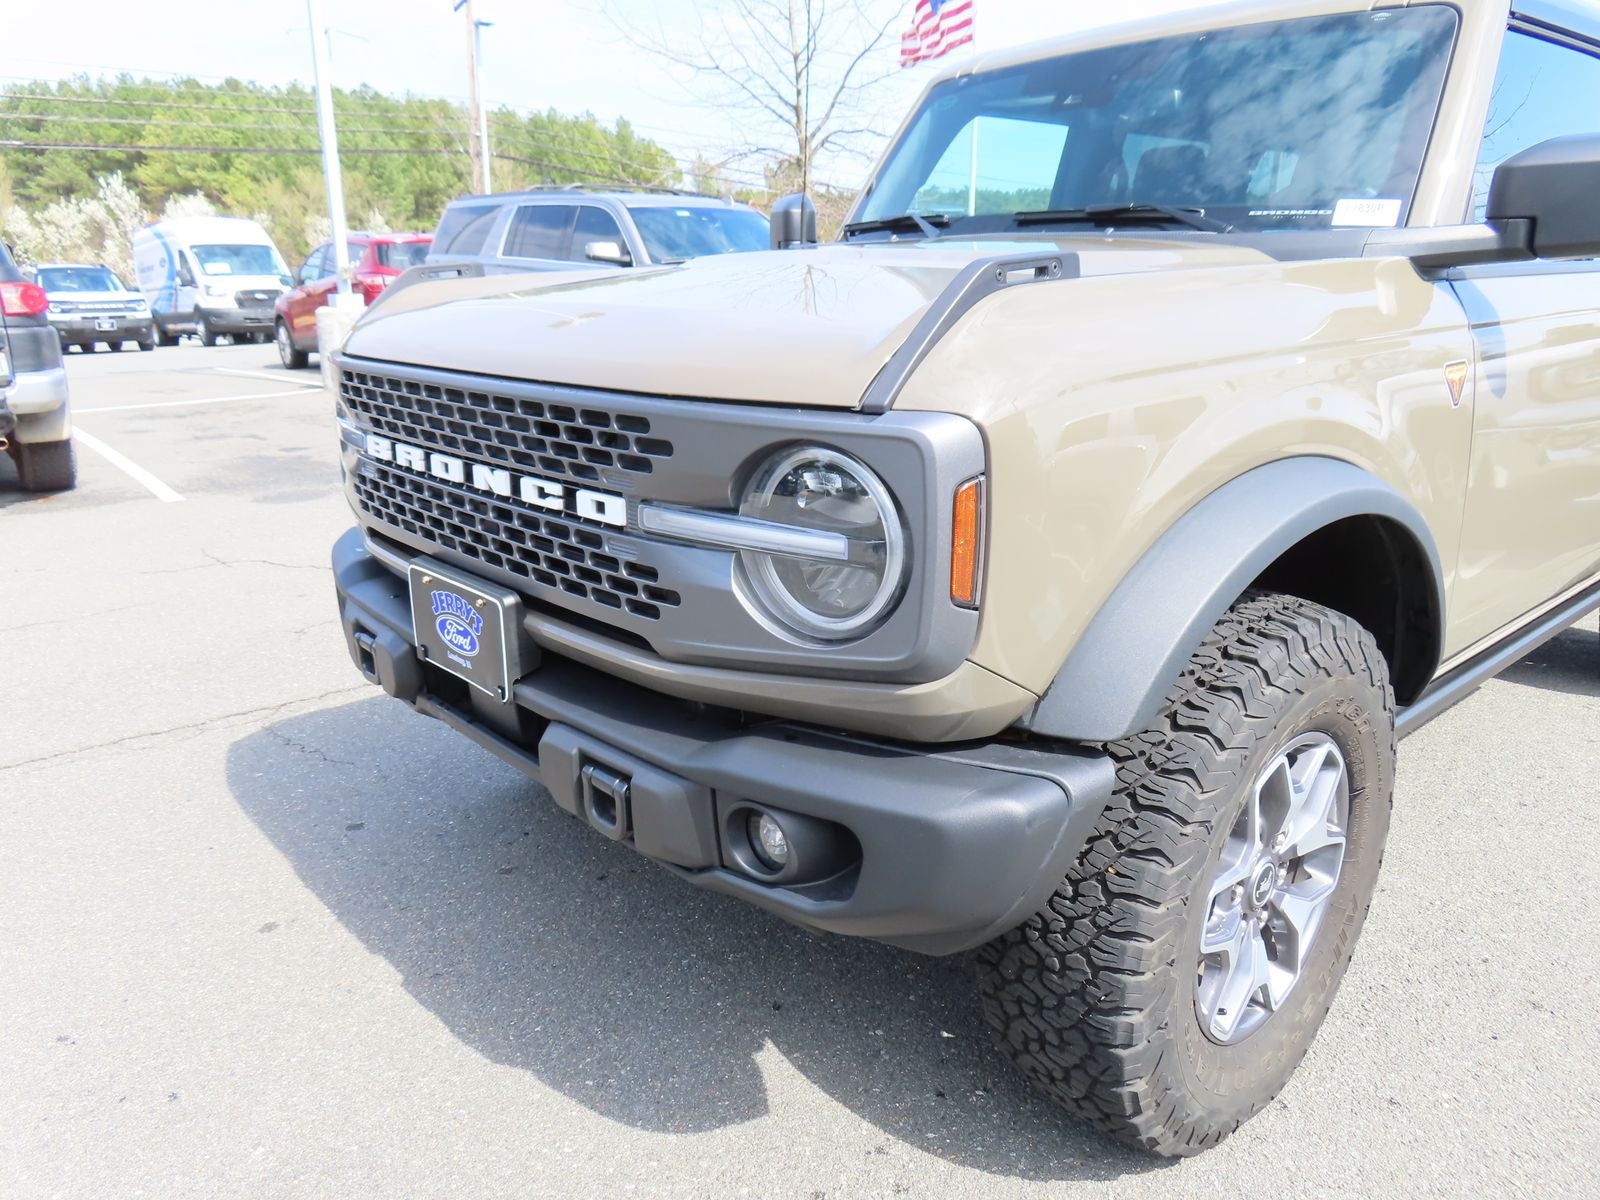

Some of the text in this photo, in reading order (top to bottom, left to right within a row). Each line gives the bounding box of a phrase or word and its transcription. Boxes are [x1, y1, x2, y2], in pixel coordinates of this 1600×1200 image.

[1248, 209, 1333, 217] BRONCO
[366, 433, 627, 526] BRONCO
[431, 590, 484, 635] JERRY'S
[443, 619, 472, 650] Ford
